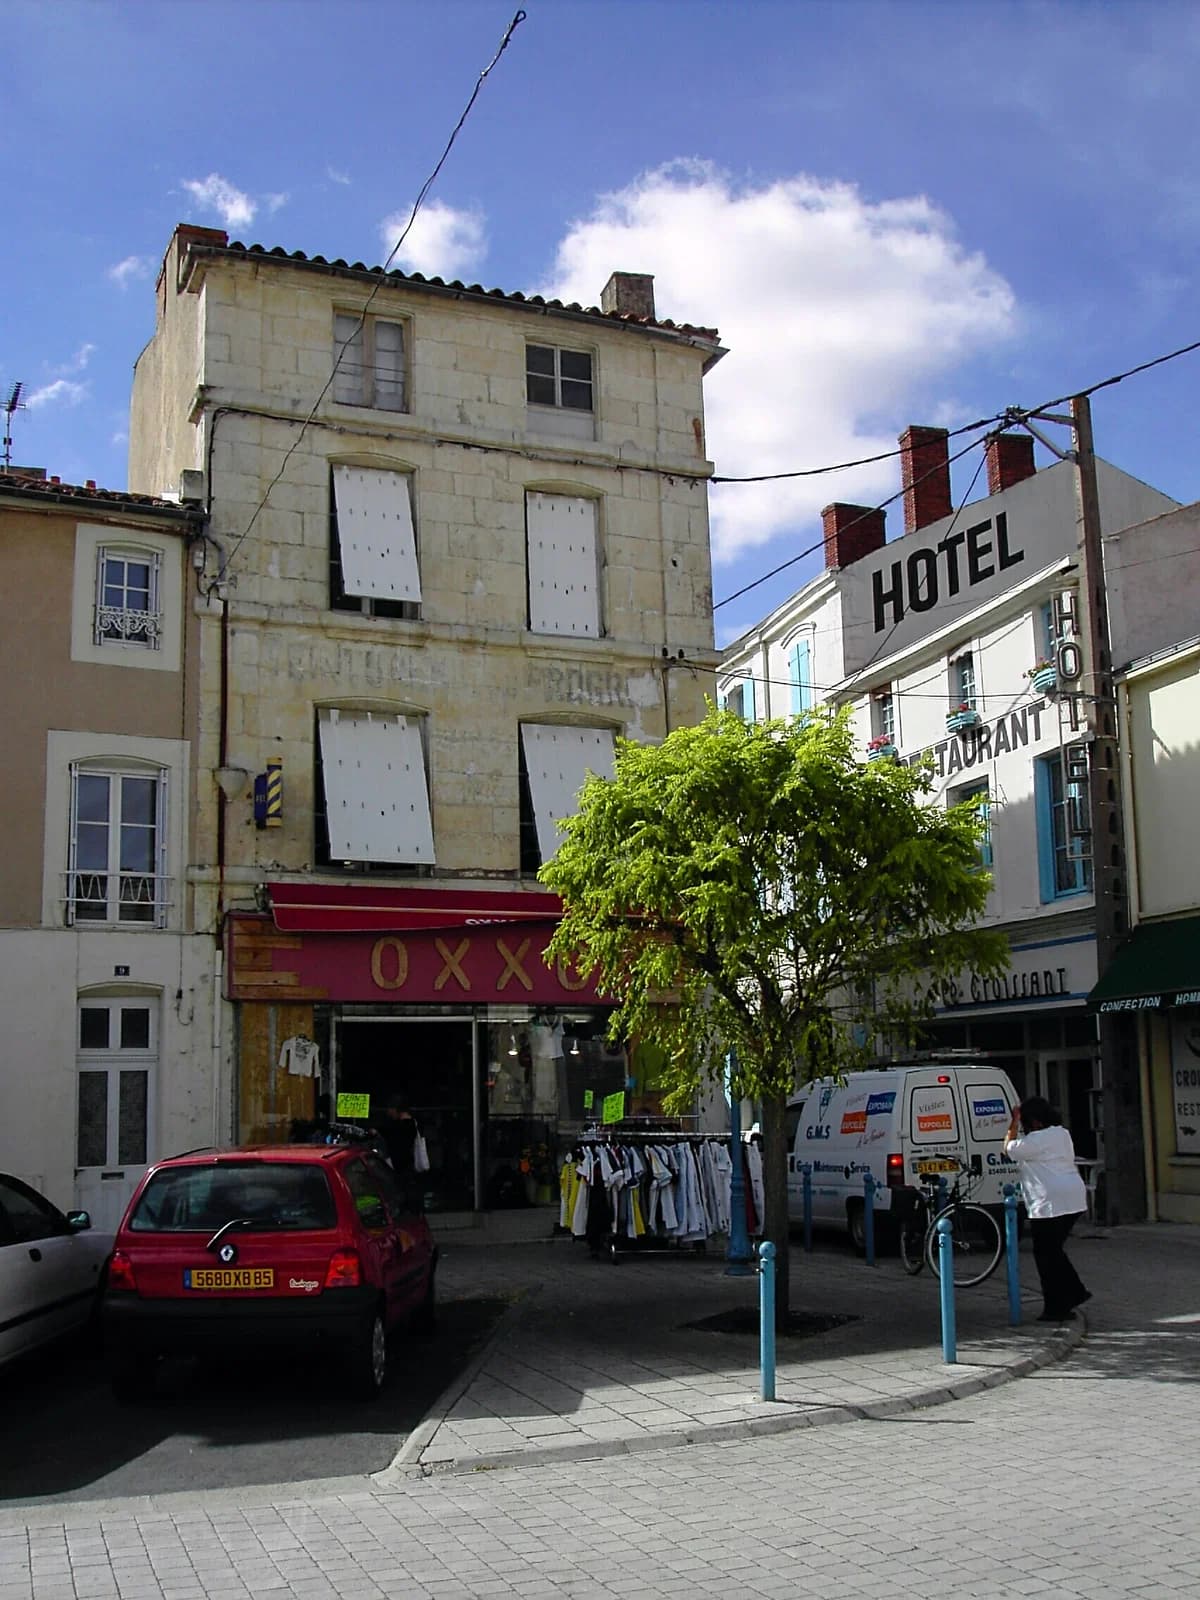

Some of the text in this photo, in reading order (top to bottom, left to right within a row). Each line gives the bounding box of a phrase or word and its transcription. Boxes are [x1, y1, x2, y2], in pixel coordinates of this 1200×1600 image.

[872, 511, 1025, 633] HOTEL
[896, 700, 1046, 786] TAURANT
[1053, 594, 1092, 837] HOTEL
[1101, 996, 1161, 1012] CONFECTION
